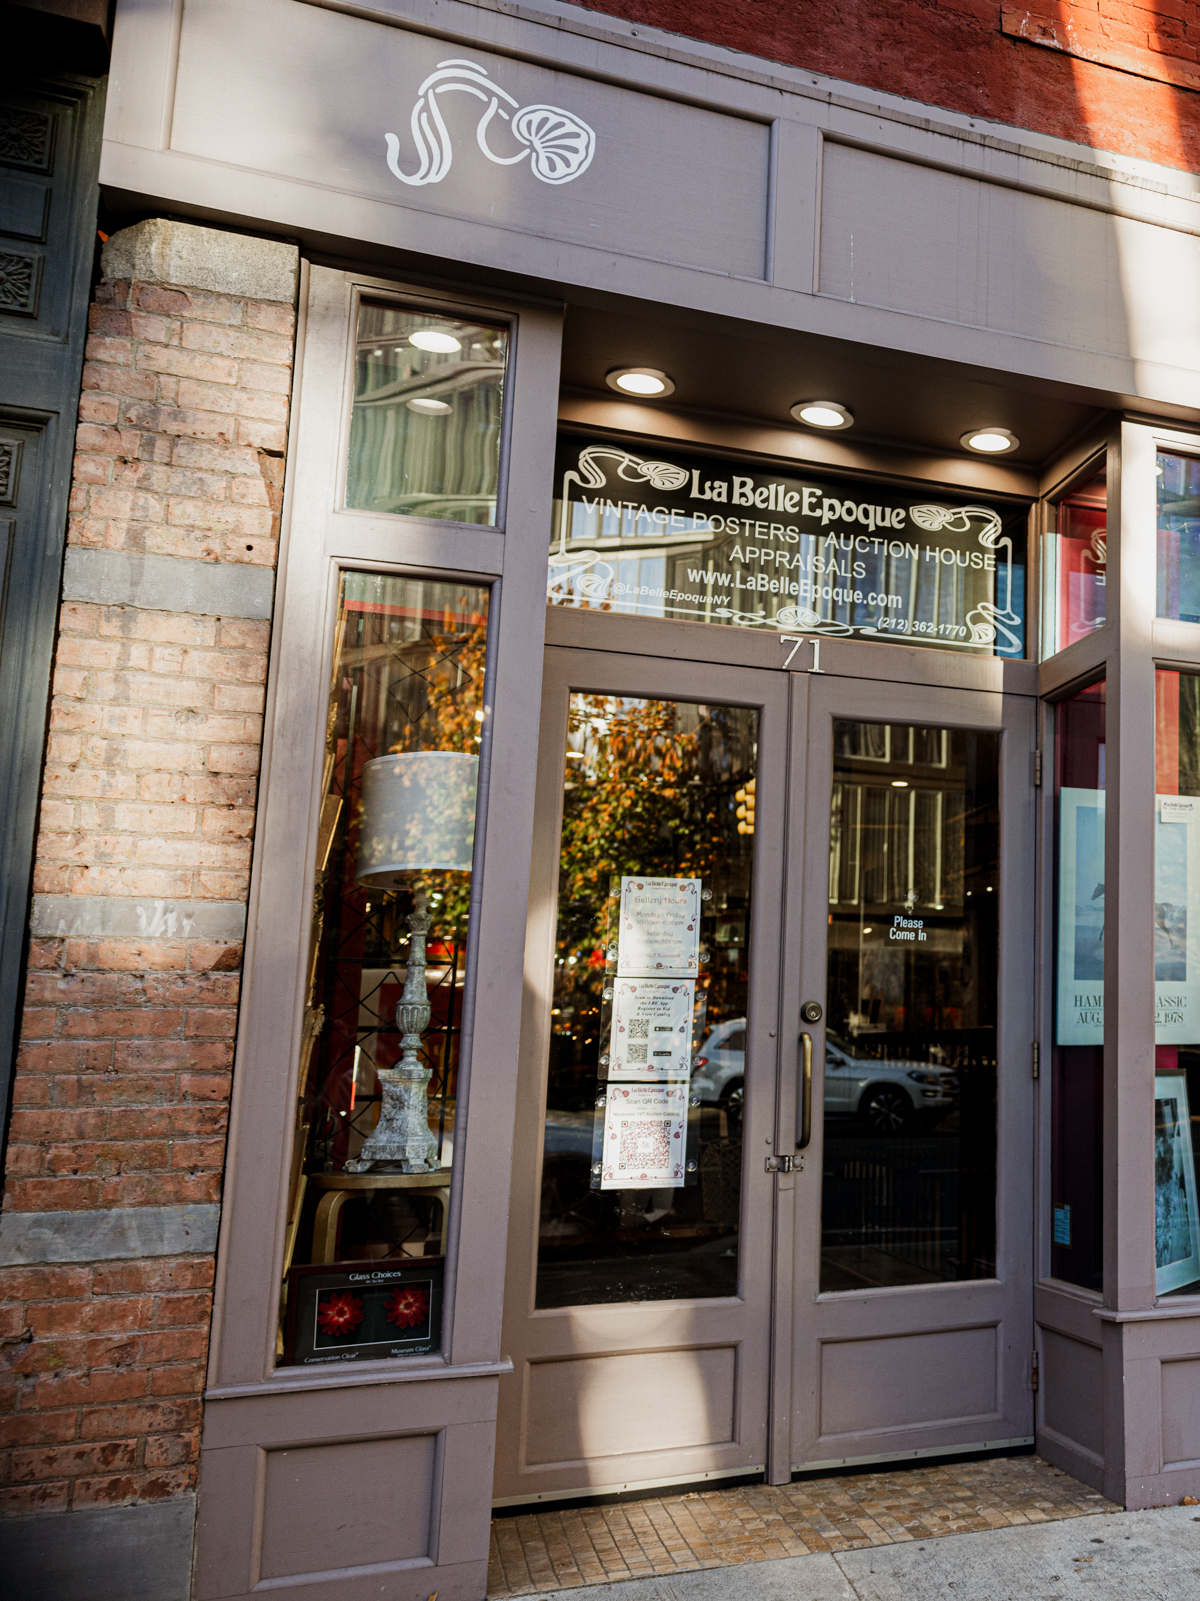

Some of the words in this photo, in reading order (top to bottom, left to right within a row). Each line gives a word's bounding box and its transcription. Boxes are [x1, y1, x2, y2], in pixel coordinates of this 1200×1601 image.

[582, 495, 685, 527] VINTAGE
[693, 512, 800, 544] POSTERS
[824, 531, 919, 560] AUCTION
[926, 546, 996, 571] HOUSE
[729, 545, 866, 579] APPRAISALS
[613, 582, 731, 606] @LaBelleEpoqueNY
[687, 567, 902, 609] www.LaBelleEpoque.com
[877, 616, 908, 633] (212)
[912, 620, 967, 638] 362-1770
[779, 635, 825, 674] 71
[634, 896, 663, 904] Gallery
[894, 915, 923, 928] Please
[889, 927, 915, 940] Come
[918, 929, 927, 941] In
[1074, 995, 1104, 1008] HAM
[1156, 996, 1187, 1008] ASSIC
[1077, 1012, 1102, 1024] AUG.
[1164, 1012, 1184, 1024] 1978
[349, 1273, 370, 1281] Glass
[371, 1271, 402, 1279] Choices
[304, 1354, 341, 1364] Conservation
